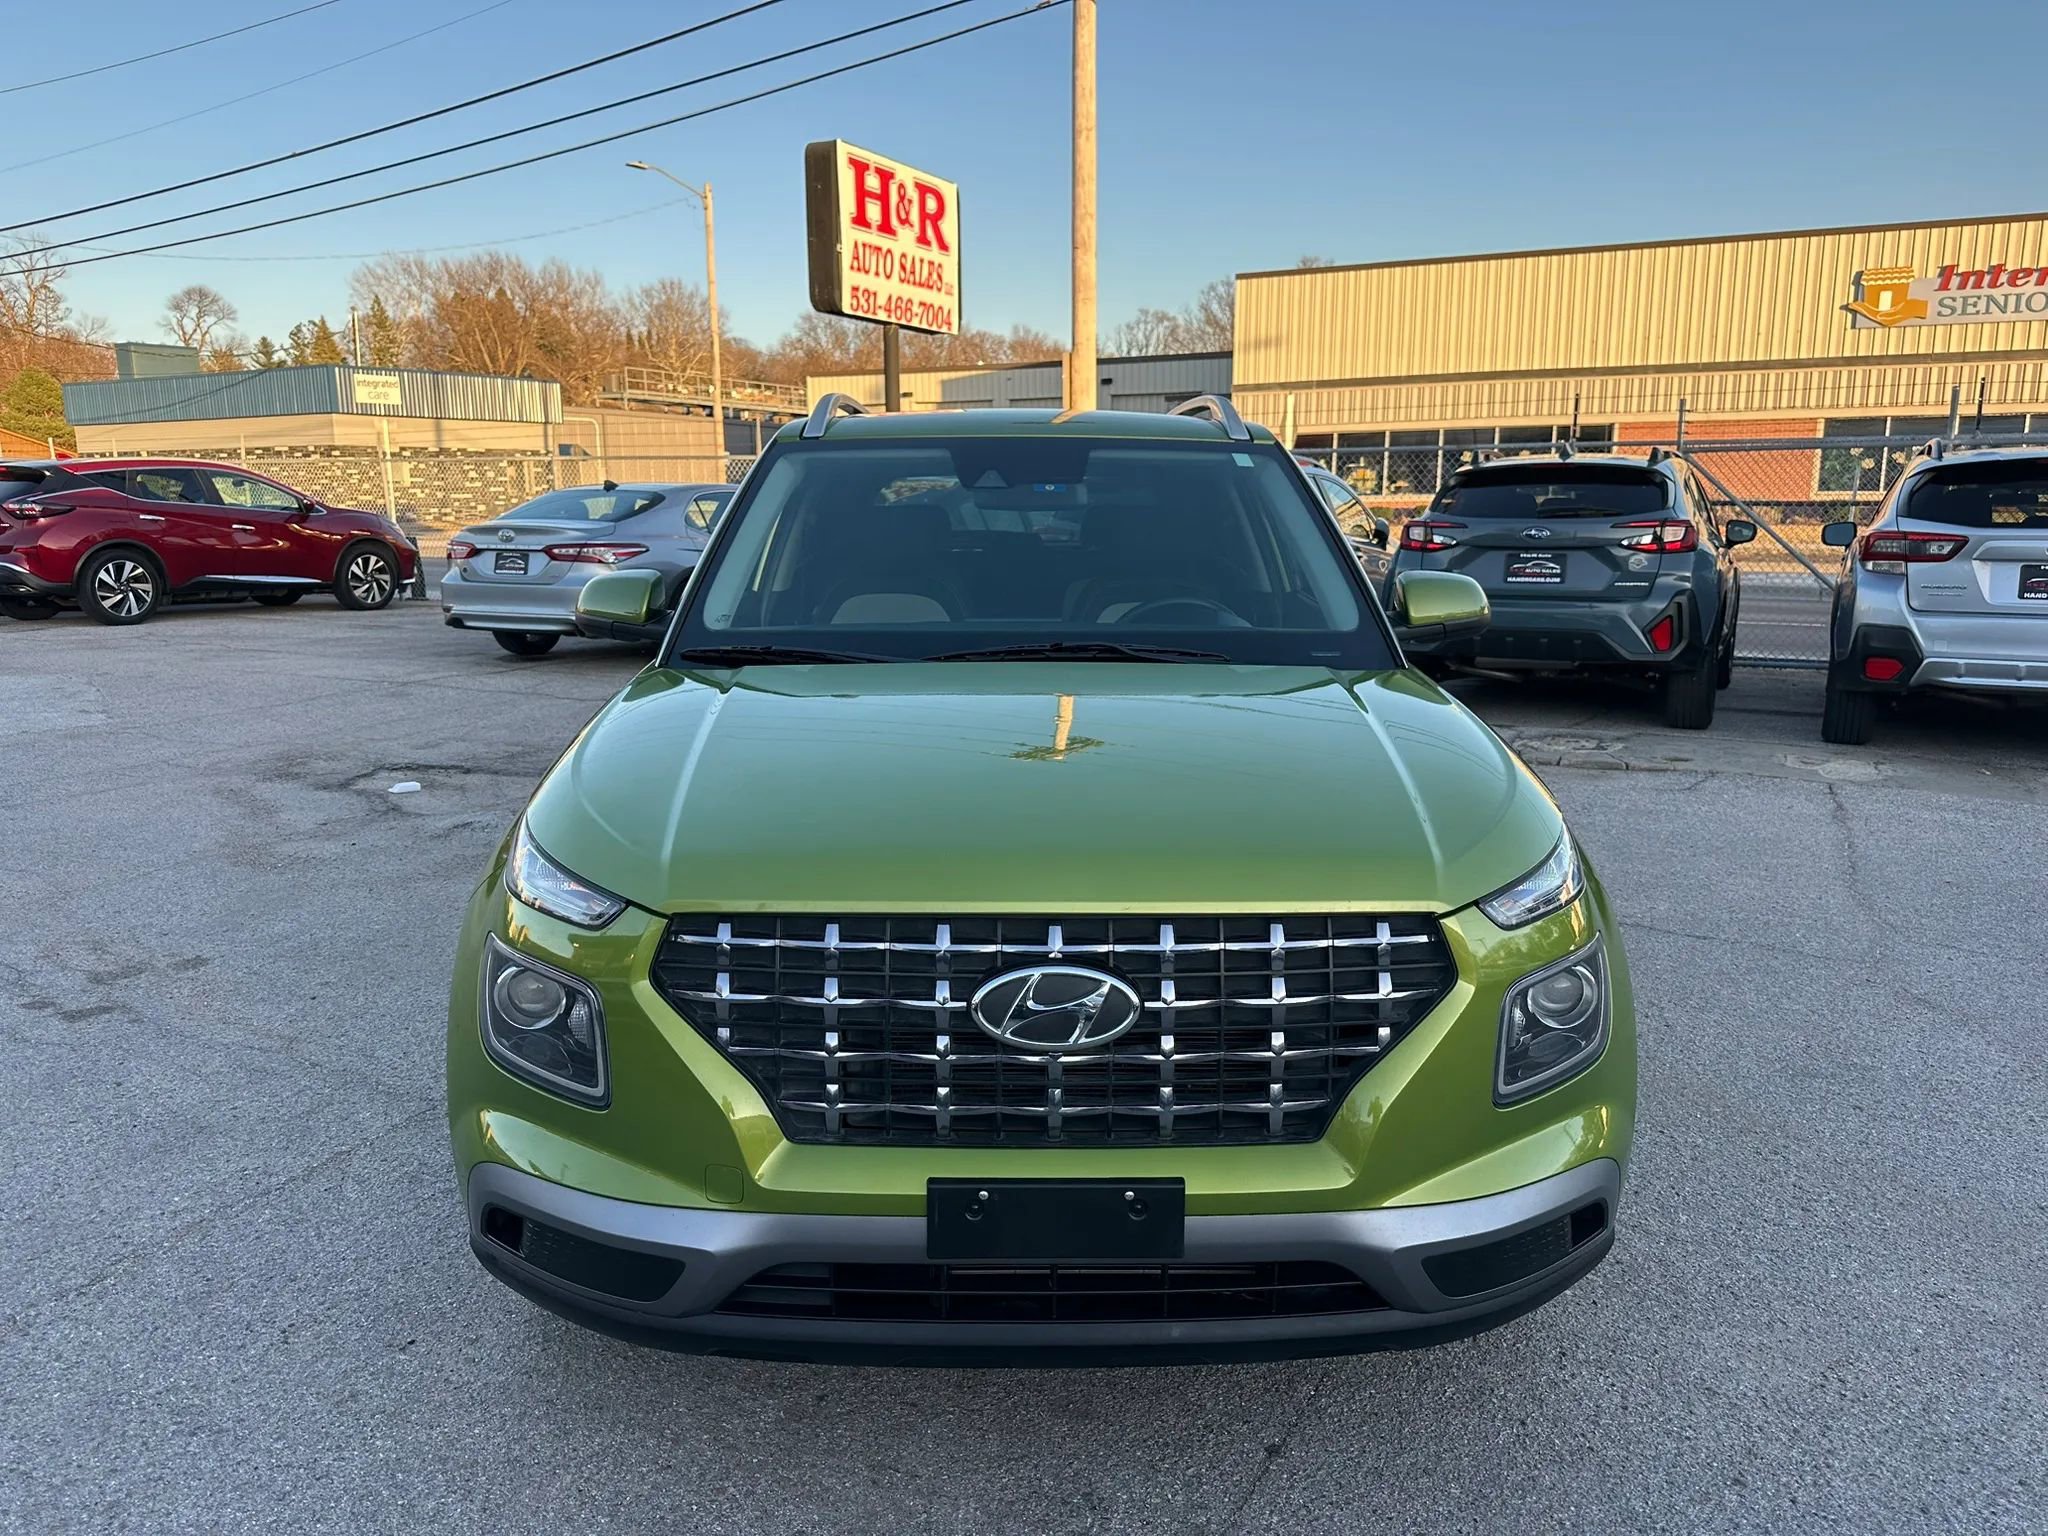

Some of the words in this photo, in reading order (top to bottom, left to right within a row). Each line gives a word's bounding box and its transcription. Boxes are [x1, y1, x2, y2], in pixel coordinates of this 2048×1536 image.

[848, 155, 950, 253] H&R
[850, 240, 894, 281] AUTO
[899, 252, 943, 293] SALES
[850, 286, 953, 332] 531-466-7004
[1937, 291, 2048, 318] SENIO
[368, 391, 389, 400] care
